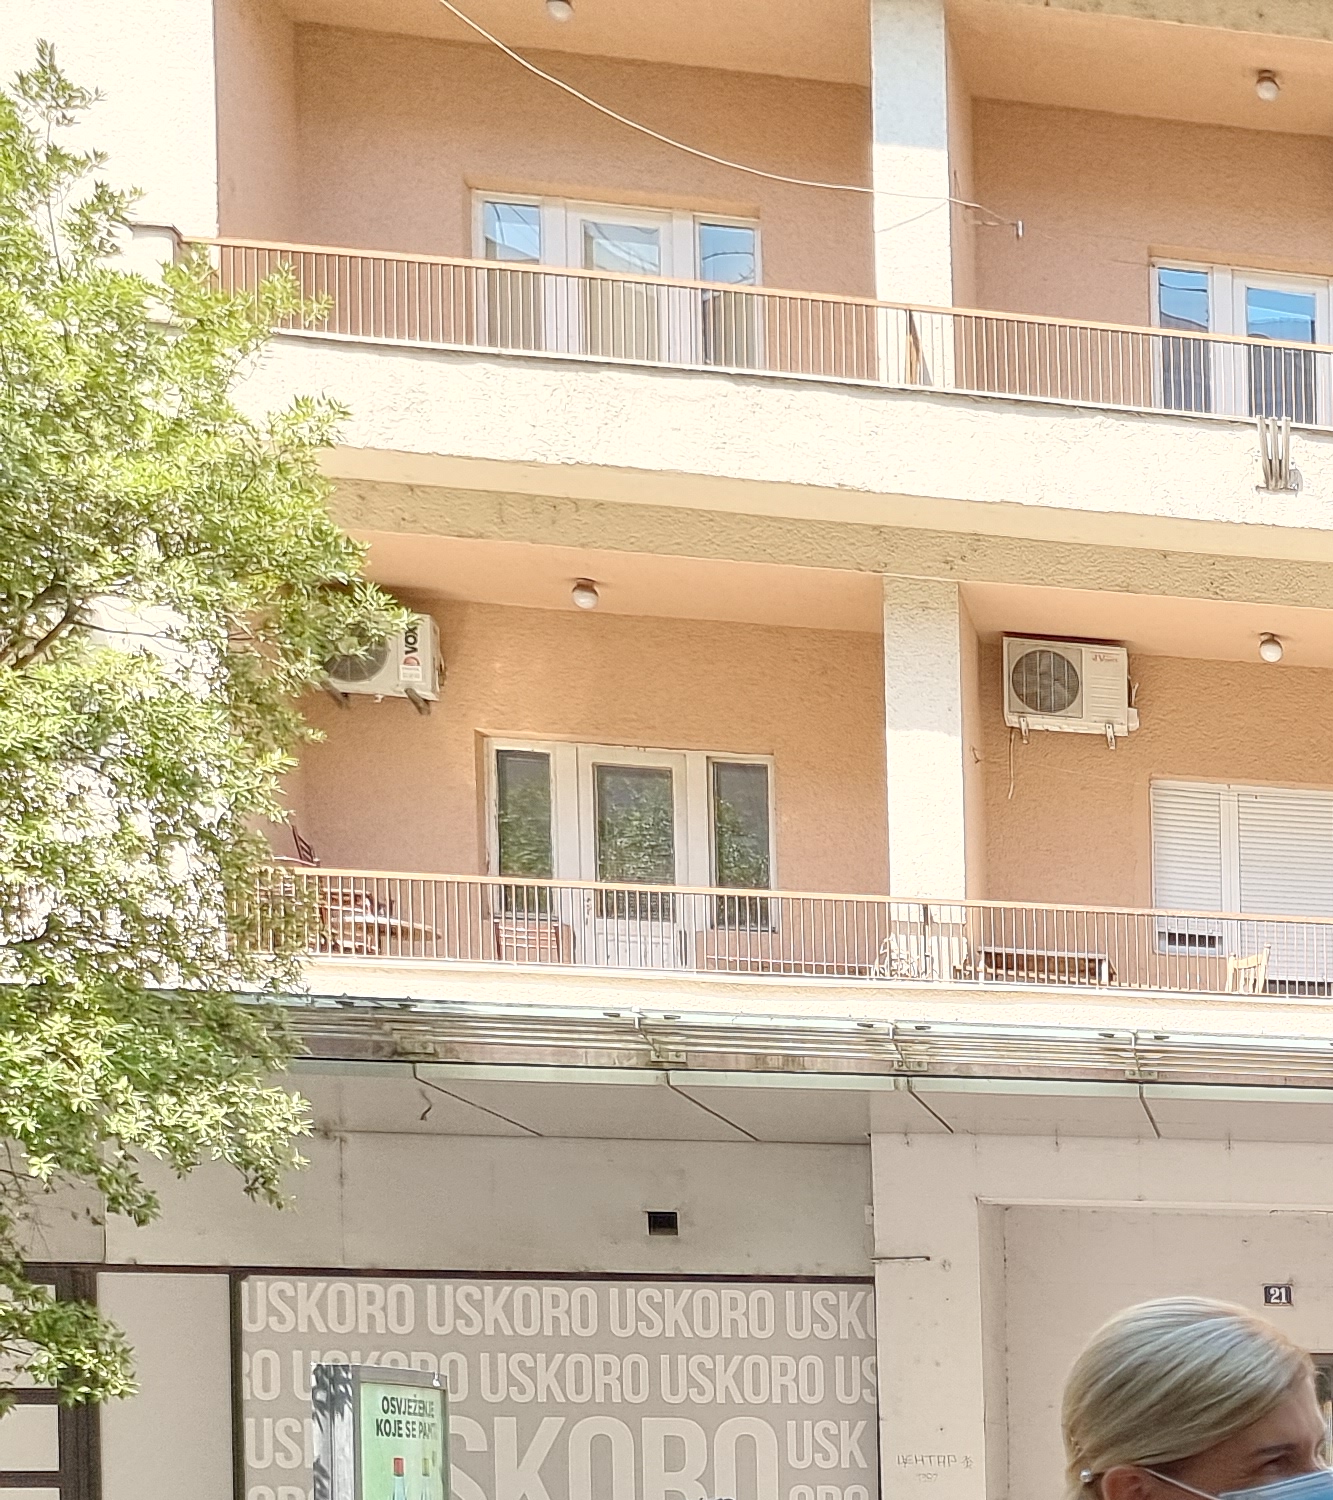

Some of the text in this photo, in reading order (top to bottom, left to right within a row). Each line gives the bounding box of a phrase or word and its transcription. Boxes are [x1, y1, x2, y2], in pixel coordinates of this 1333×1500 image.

[242, 1281, 415, 1335] USKORO
[427, 1284, 599, 1338] USKORO
[609, 1287, 775, 1339] USKORO
[1269, 1286, 1288, 1303] 21
[480, 1352, 650, 1403] USKORO
[660, 1354, 825, 1405] USKORO
[246, 1417, 314, 1470] US
[375, 1418, 403, 1438] KOJE
[405, 1420, 417, 1438] SE
[786, 1419, 869, 1470] USK
